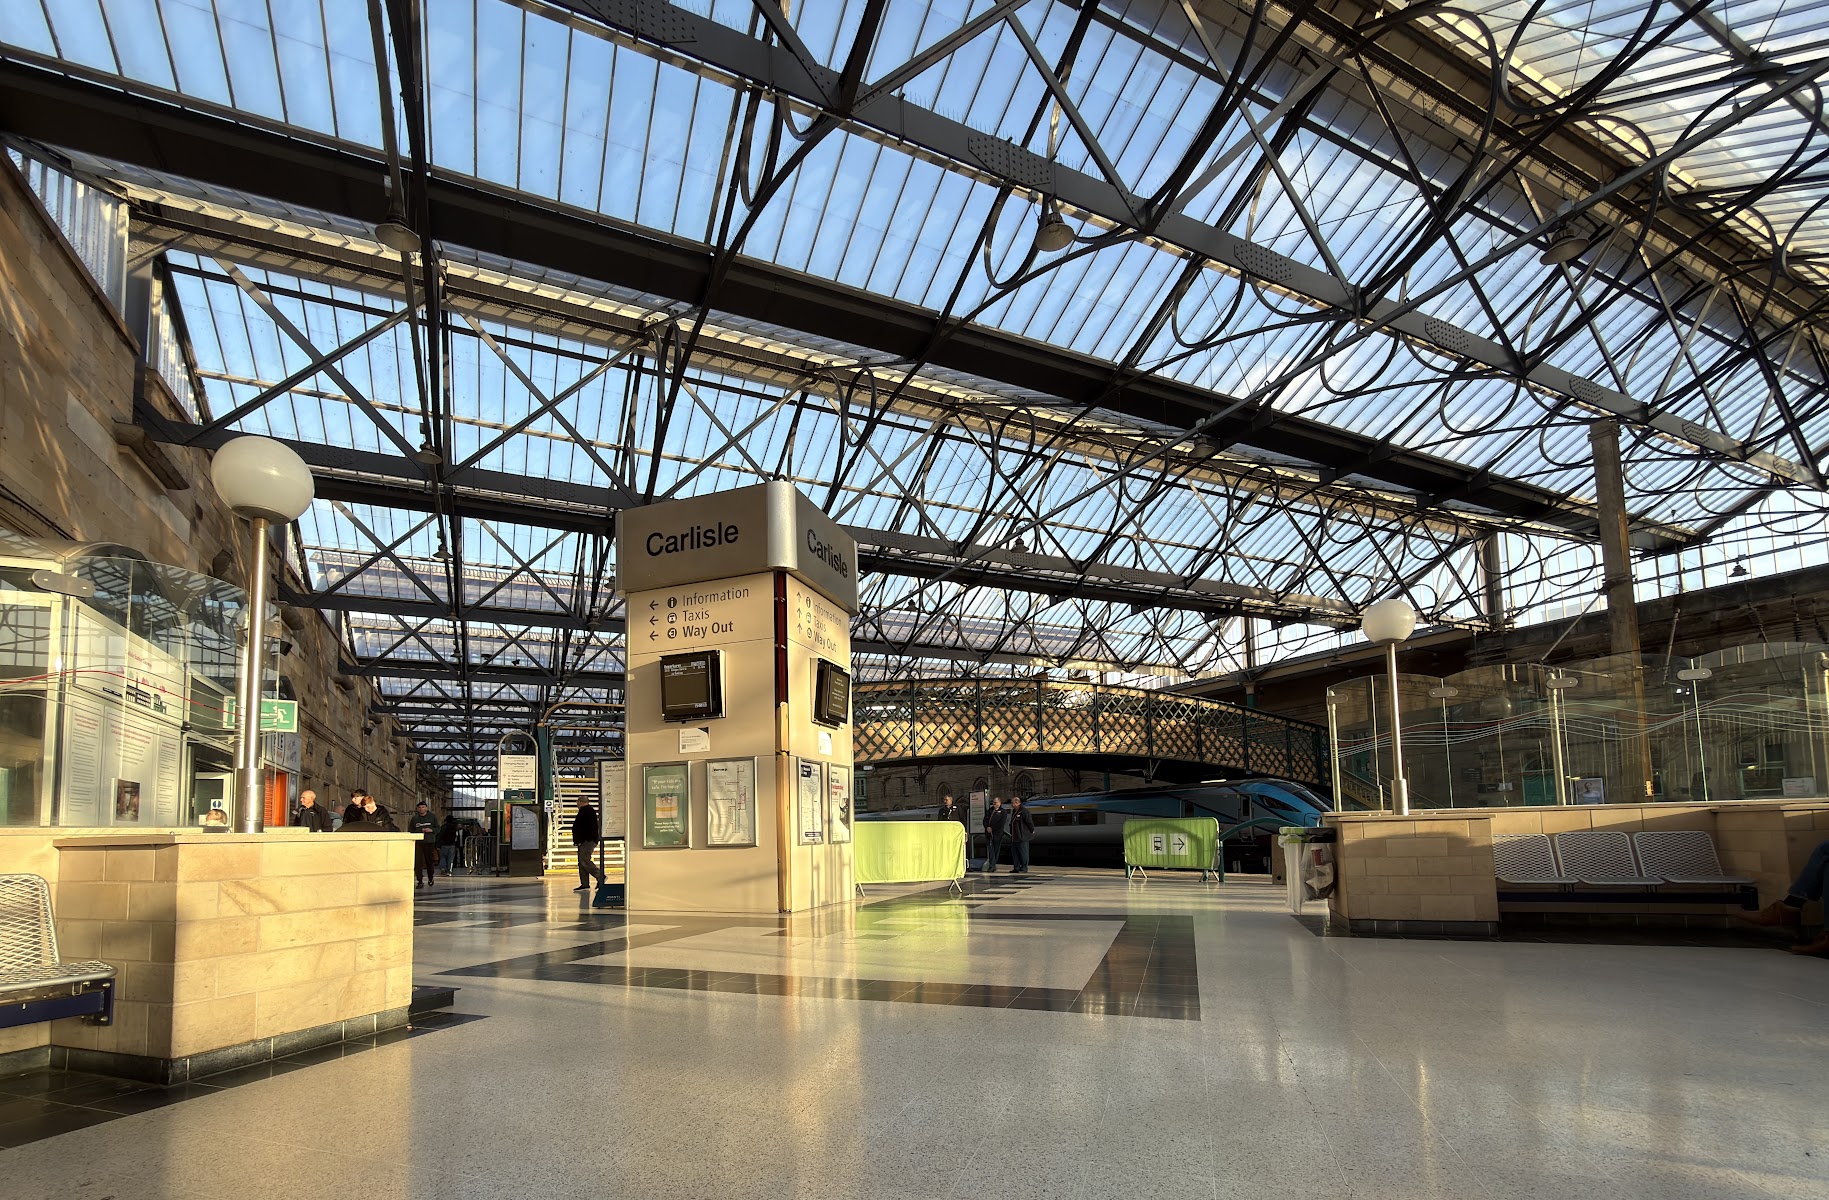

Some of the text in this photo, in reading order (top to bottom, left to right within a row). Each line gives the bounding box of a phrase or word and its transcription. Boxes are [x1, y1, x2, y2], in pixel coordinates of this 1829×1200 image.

[646, 522, 739, 557] Carlisle
[807, 529, 848, 579] Carlisle
[683, 587, 749, 607] Information
[682, 608, 710, 622] Taxis
[813, 600, 842, 627] Information
[813, 615, 827, 633] Taxis
[682, 621, 734, 639] Way Out
[813, 630, 837, 653] Way Out
